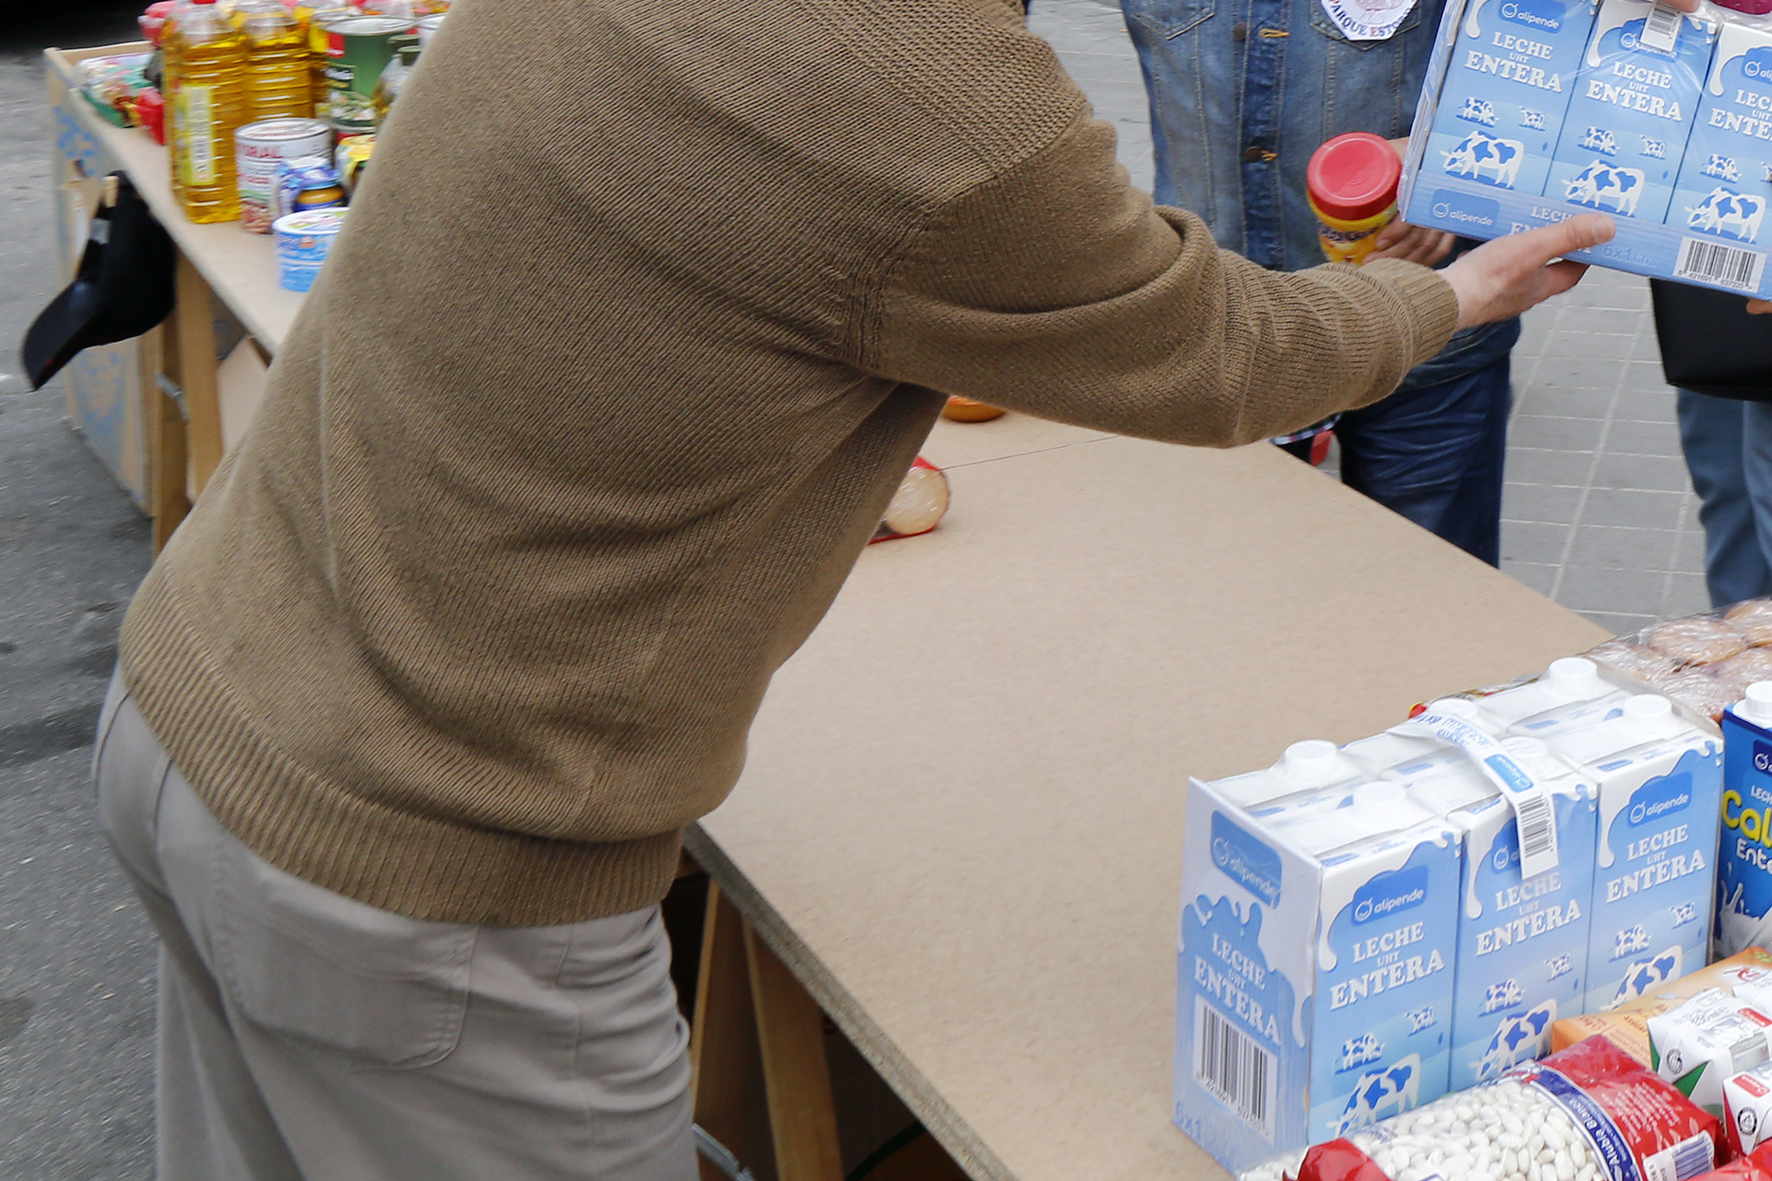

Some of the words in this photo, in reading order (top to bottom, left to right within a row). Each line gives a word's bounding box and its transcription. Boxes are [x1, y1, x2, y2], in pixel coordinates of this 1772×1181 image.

[1518, 11, 1560, 30] alipende
[1491, 31, 1554, 60] LECHE
[1509, 51, 1529, 64] UHT
[1464, 50, 1563, 93] ENTERA
[1612, 60, 1673, 90] LECHE
[1585, 79, 1683, 123] ENTERA
[1629, 81, 1650, 94] UHT
[1751, 109, 1772, 121] UHT
[1450, 207, 1494, 227] alipende
[1530, 205, 1575, 224] LECH
[1645, 792, 1690, 817] alipende
[1627, 823, 1690, 862] LECHE
[1646, 850, 1668, 865] UHT
[1495, 871, 1562, 912] LECHE
[1605, 849, 1707, 905] ENTERA
[1373, 887, 1425, 914] alipende
[1518, 901, 1541, 916] UHT
[1475, 898, 1583, 957] ENTERA
[1353, 921, 1425, 964] LECHE
[1211, 932, 1266, 991] LECHE
[1377, 950, 1400, 967] UHT
[1329, 948, 1446, 1011] ENTERA
[1193, 954, 1283, 1046] ENTERA
